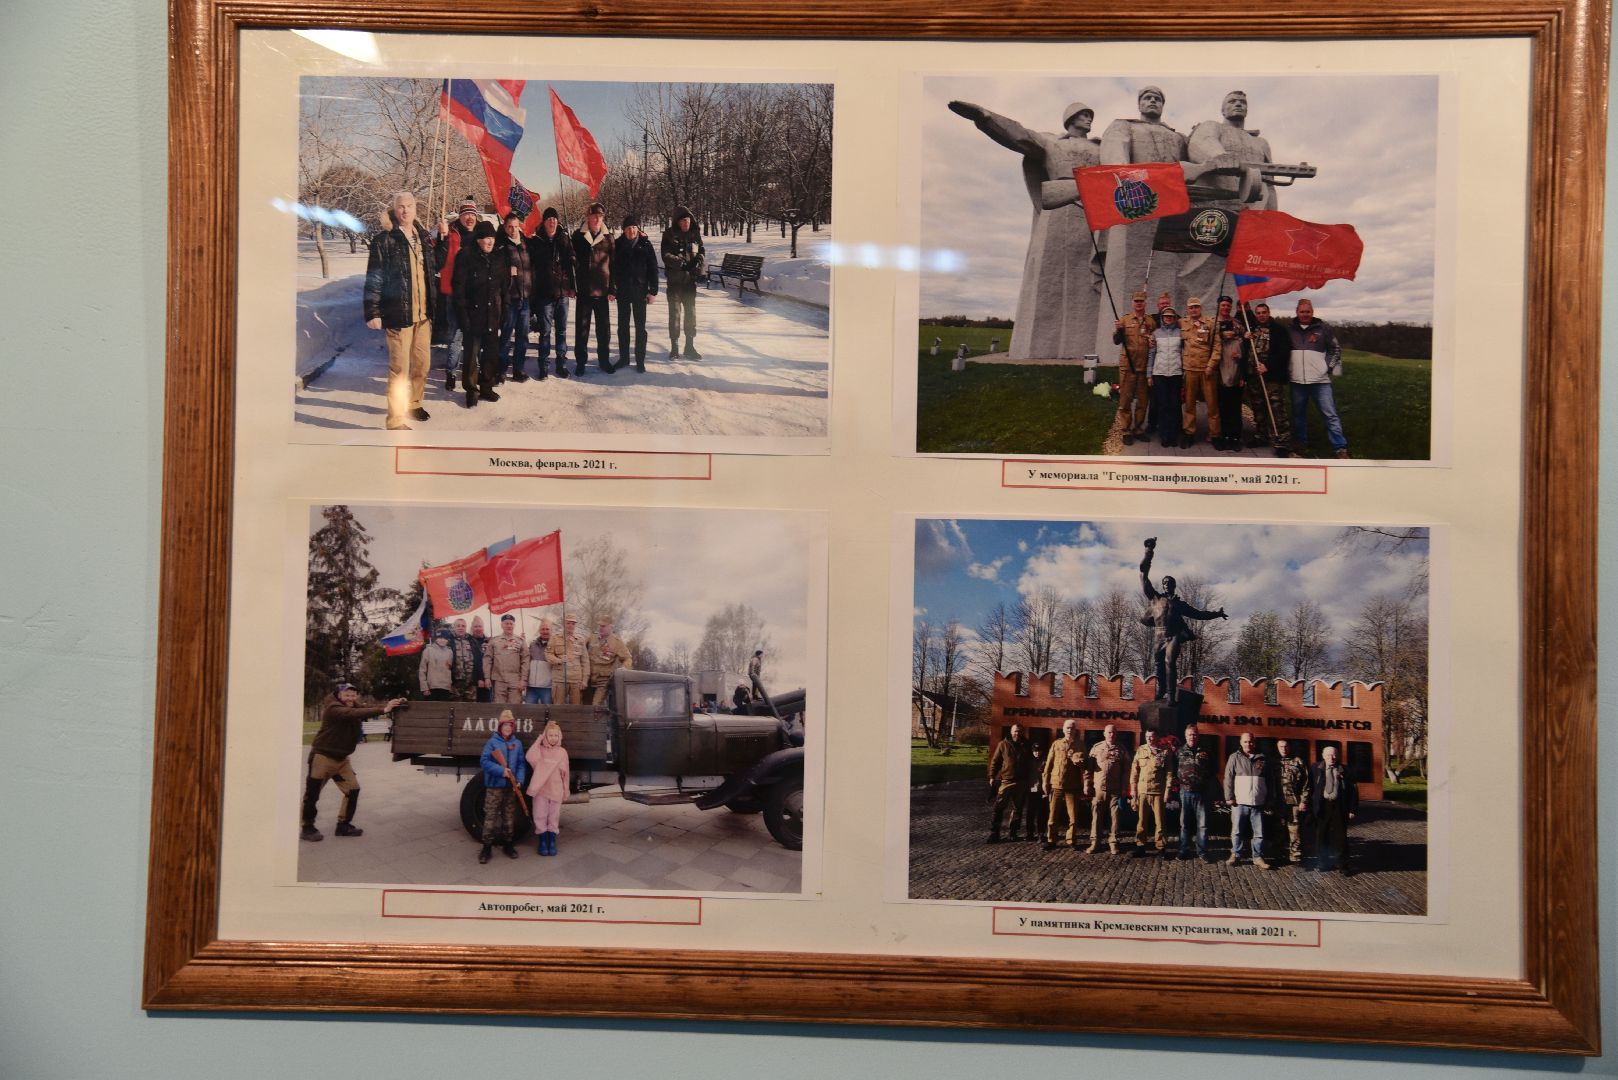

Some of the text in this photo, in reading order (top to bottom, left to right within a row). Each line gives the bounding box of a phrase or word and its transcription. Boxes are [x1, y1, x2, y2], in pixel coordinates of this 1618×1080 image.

[1246, 254, 1262, 265] 201
[489, 457, 617, 470] Москва, февраль 2021 г.
[1028, 469, 1301, 485] У мемориала "Героям-панфиловцам", май 2021 г.
[1233, 716, 1263, 726] 1941
[1267, 717, 1372, 731] ПОСВЯЩАЕТСЯ
[478, 902, 605, 914] Автопробег, май 2021 г.
[1019, 917, 1297, 938] У памятника Кремлевским курсантам, май 2021 г.
